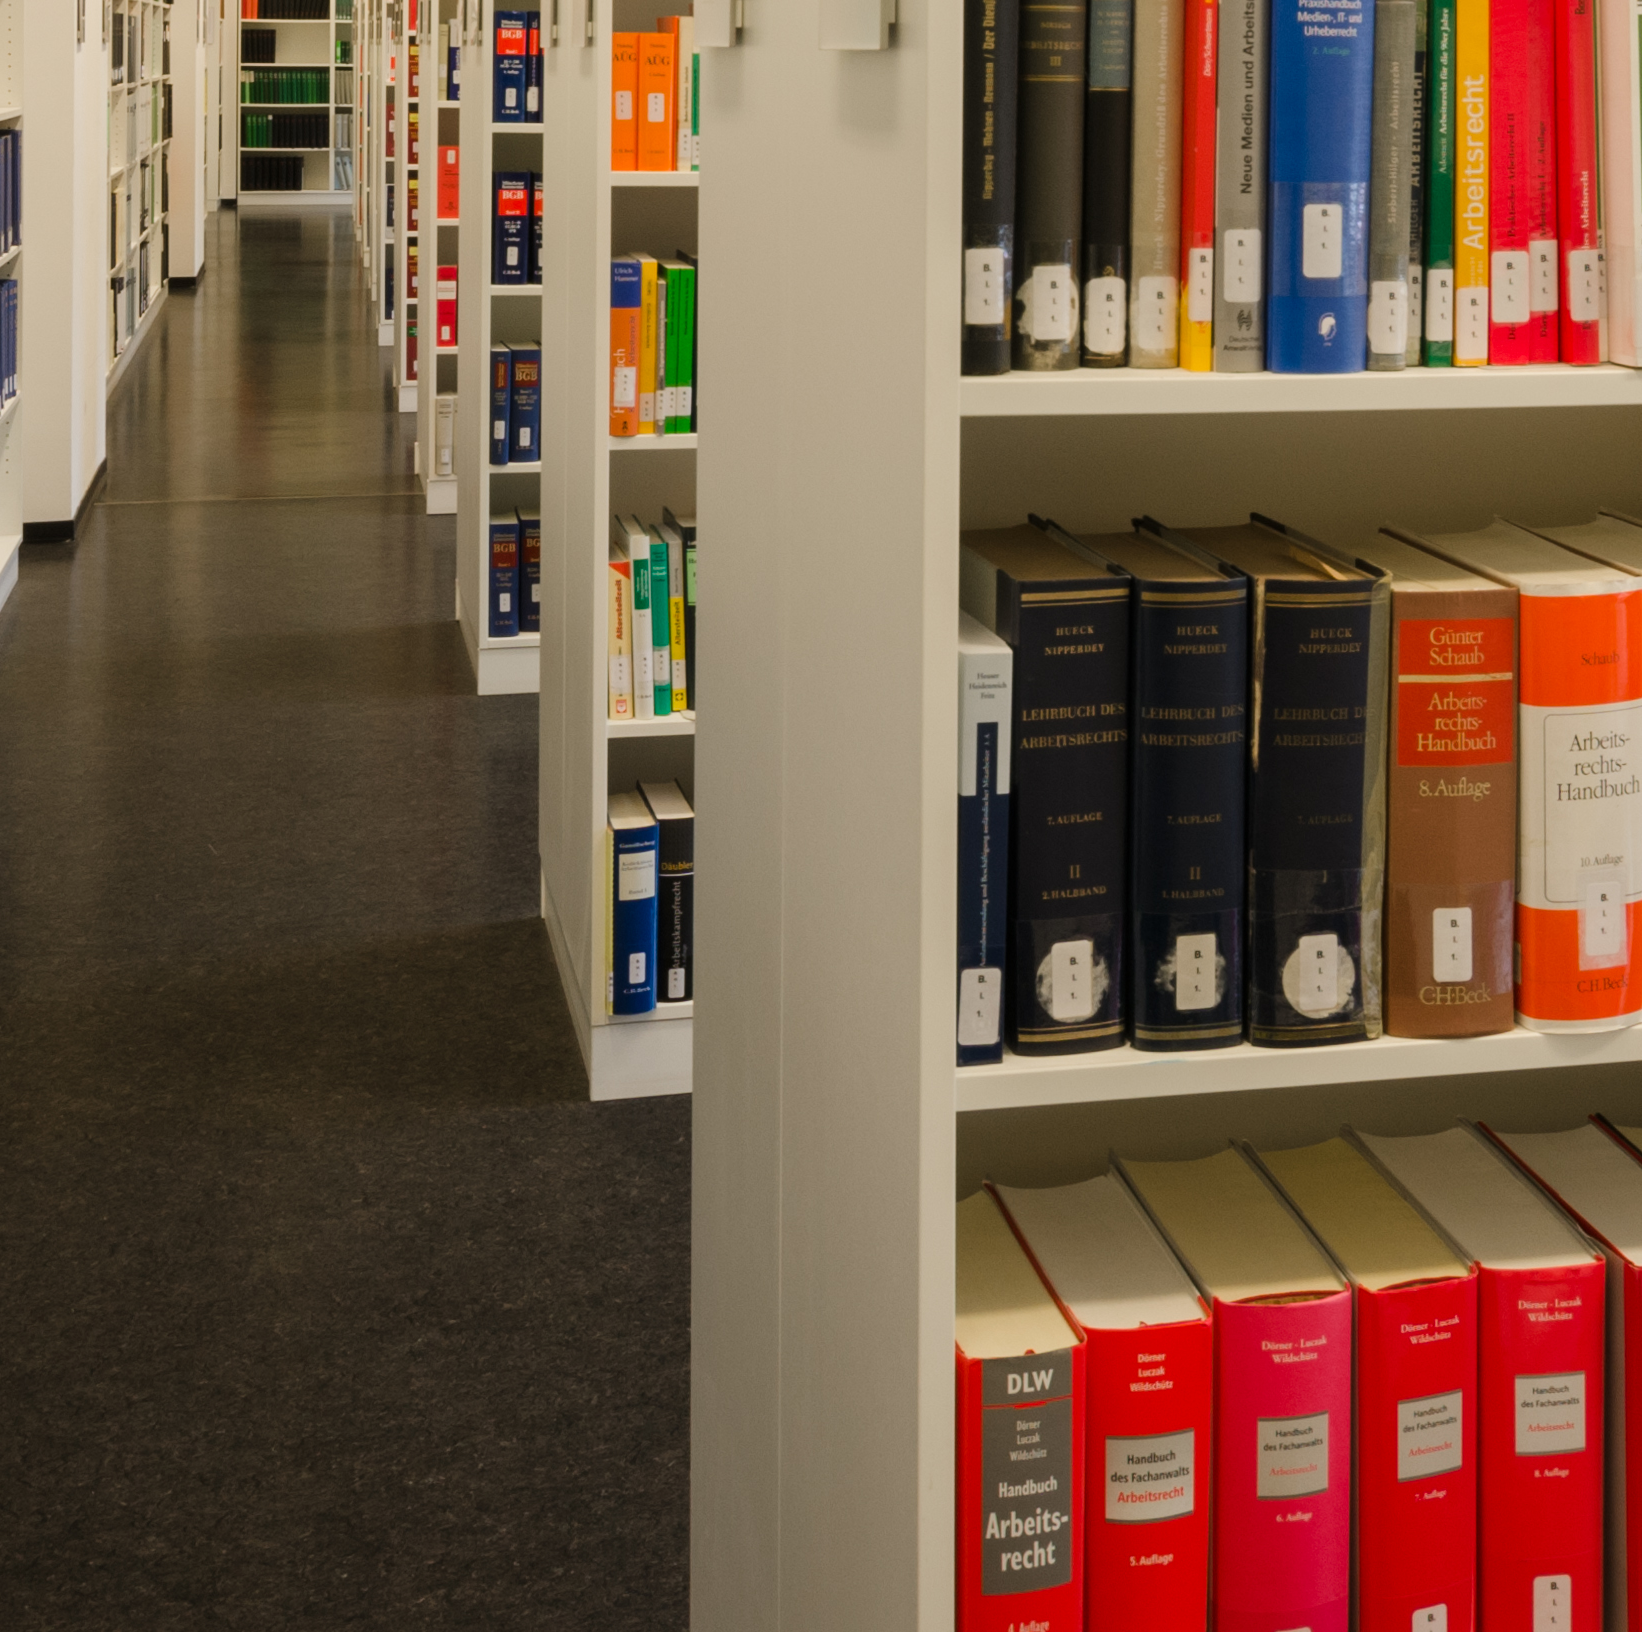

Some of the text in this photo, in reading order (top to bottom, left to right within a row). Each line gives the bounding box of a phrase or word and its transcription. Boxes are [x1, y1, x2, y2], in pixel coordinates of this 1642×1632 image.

[1348, 11, 1363, 24] und
[1304, 24, 1358, 39] Urheberrecht
[1245, 60, 1254, 90] und
[1240, 94, 1254, 151] Medien
[1462, 73, 1485, 251] Arbeitsrecht
[1240, 156, 1253, 195] Neue
[1056, 625, 1095, 637] HUECK
[1429, 626, 1485, 645] Günter
[1044, 643, 1105, 657] NIPPERDEY
[1429, 646, 1485, 666] Schaub
[1021, 702, 1126, 722] LEHRBUCH DES
[1427, 691, 1487, 712] Arbeits-
[1434, 713, 1483, 732] rechts-
[1019, 728, 1128, 750] ARBEITSRECHTS
[1416, 732, 1496, 753] Handbuch
[1569, 731, 1631, 753] Arbeits-
[1573, 756, 1627, 777] rechts-
[1419, 778, 1491, 802] 8. Auflage
[1556, 777, 1641, 802] Handbuch
[1007, 1368, 1054, 1395] DLW
[1126, 1449, 1176, 1466] Handbuch
[1110, 1465, 1190, 1484] des Fachanwalts
[998, 1475, 1058, 1499] Handbuch
[1116, 1485, 1185, 1505] Arbeitsrecht
[985, 1506, 1069, 1540] Arbeits-
[1000, 1540, 1057, 1573] recht
